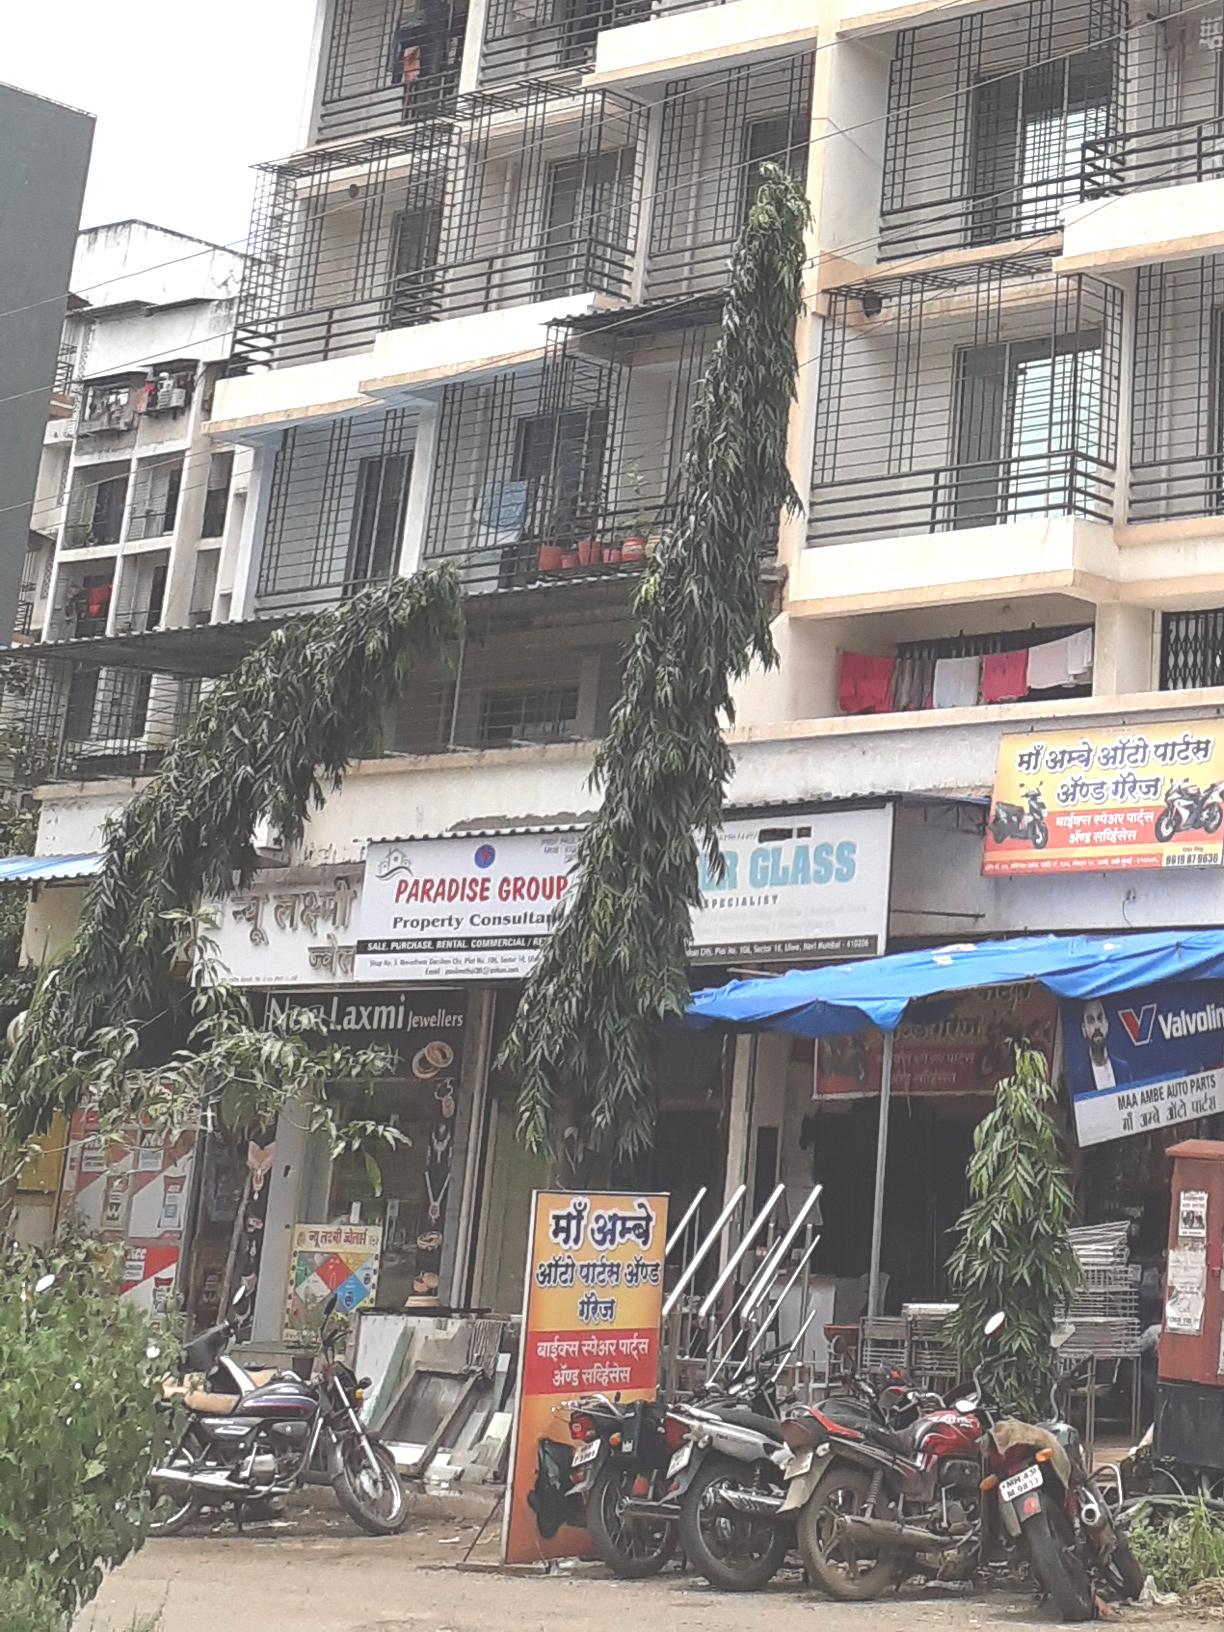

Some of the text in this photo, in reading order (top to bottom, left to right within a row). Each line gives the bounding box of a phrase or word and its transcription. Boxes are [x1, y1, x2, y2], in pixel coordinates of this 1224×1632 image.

[1097, 738, 1149, 766] ऑटो
[749, 841, 857, 889] GLASS
[394, 874, 570, 904] PARADISE GROUP
[391, 913, 465, 932] Property
[329, 993, 406, 1032] Laxmi
[407, 1008, 464, 1031] Jewellers
[1117, 1074, 1217, 1110] MAA AMBE AUTO PARTS
[551, 1201, 655, 1248] माँ अम्बे
[536, 1255, 576, 1287] ऑटो
